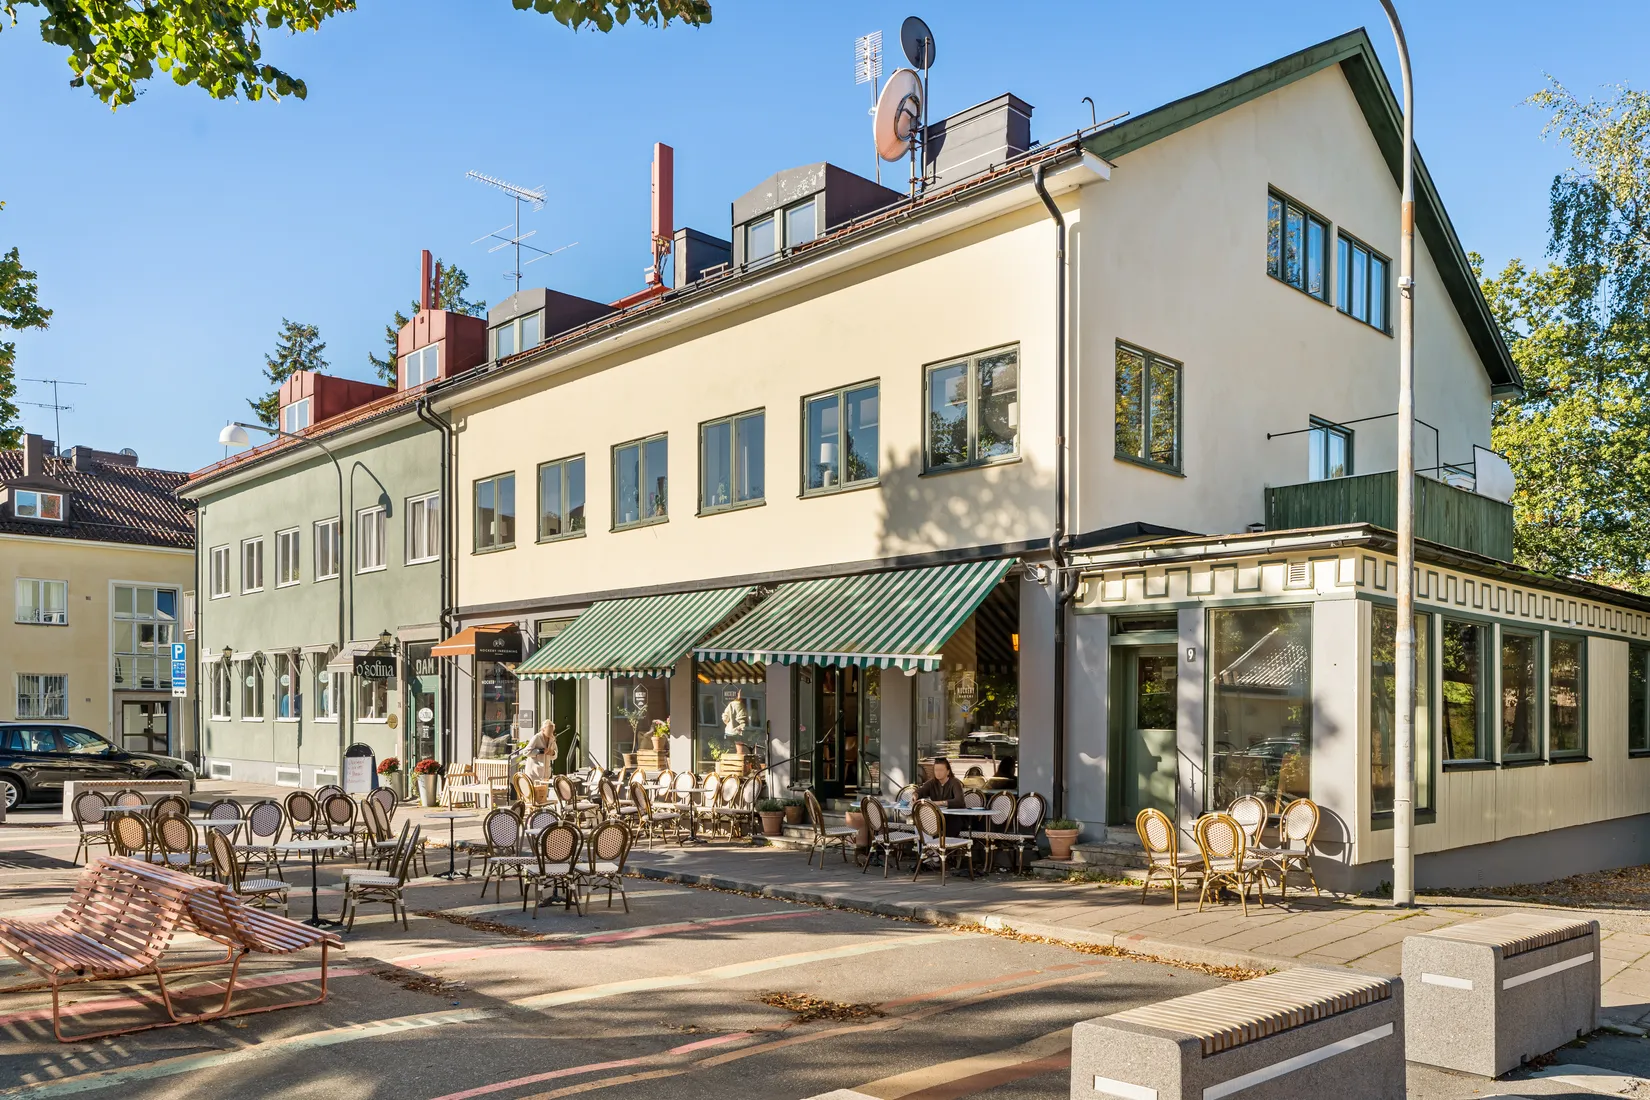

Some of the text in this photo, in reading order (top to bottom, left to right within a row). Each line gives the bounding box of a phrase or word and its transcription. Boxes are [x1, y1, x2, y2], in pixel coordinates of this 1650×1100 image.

[174, 644, 184, 660] P
[1188, 648, 1194, 660] 9
[415, 659, 434, 675] DAM
